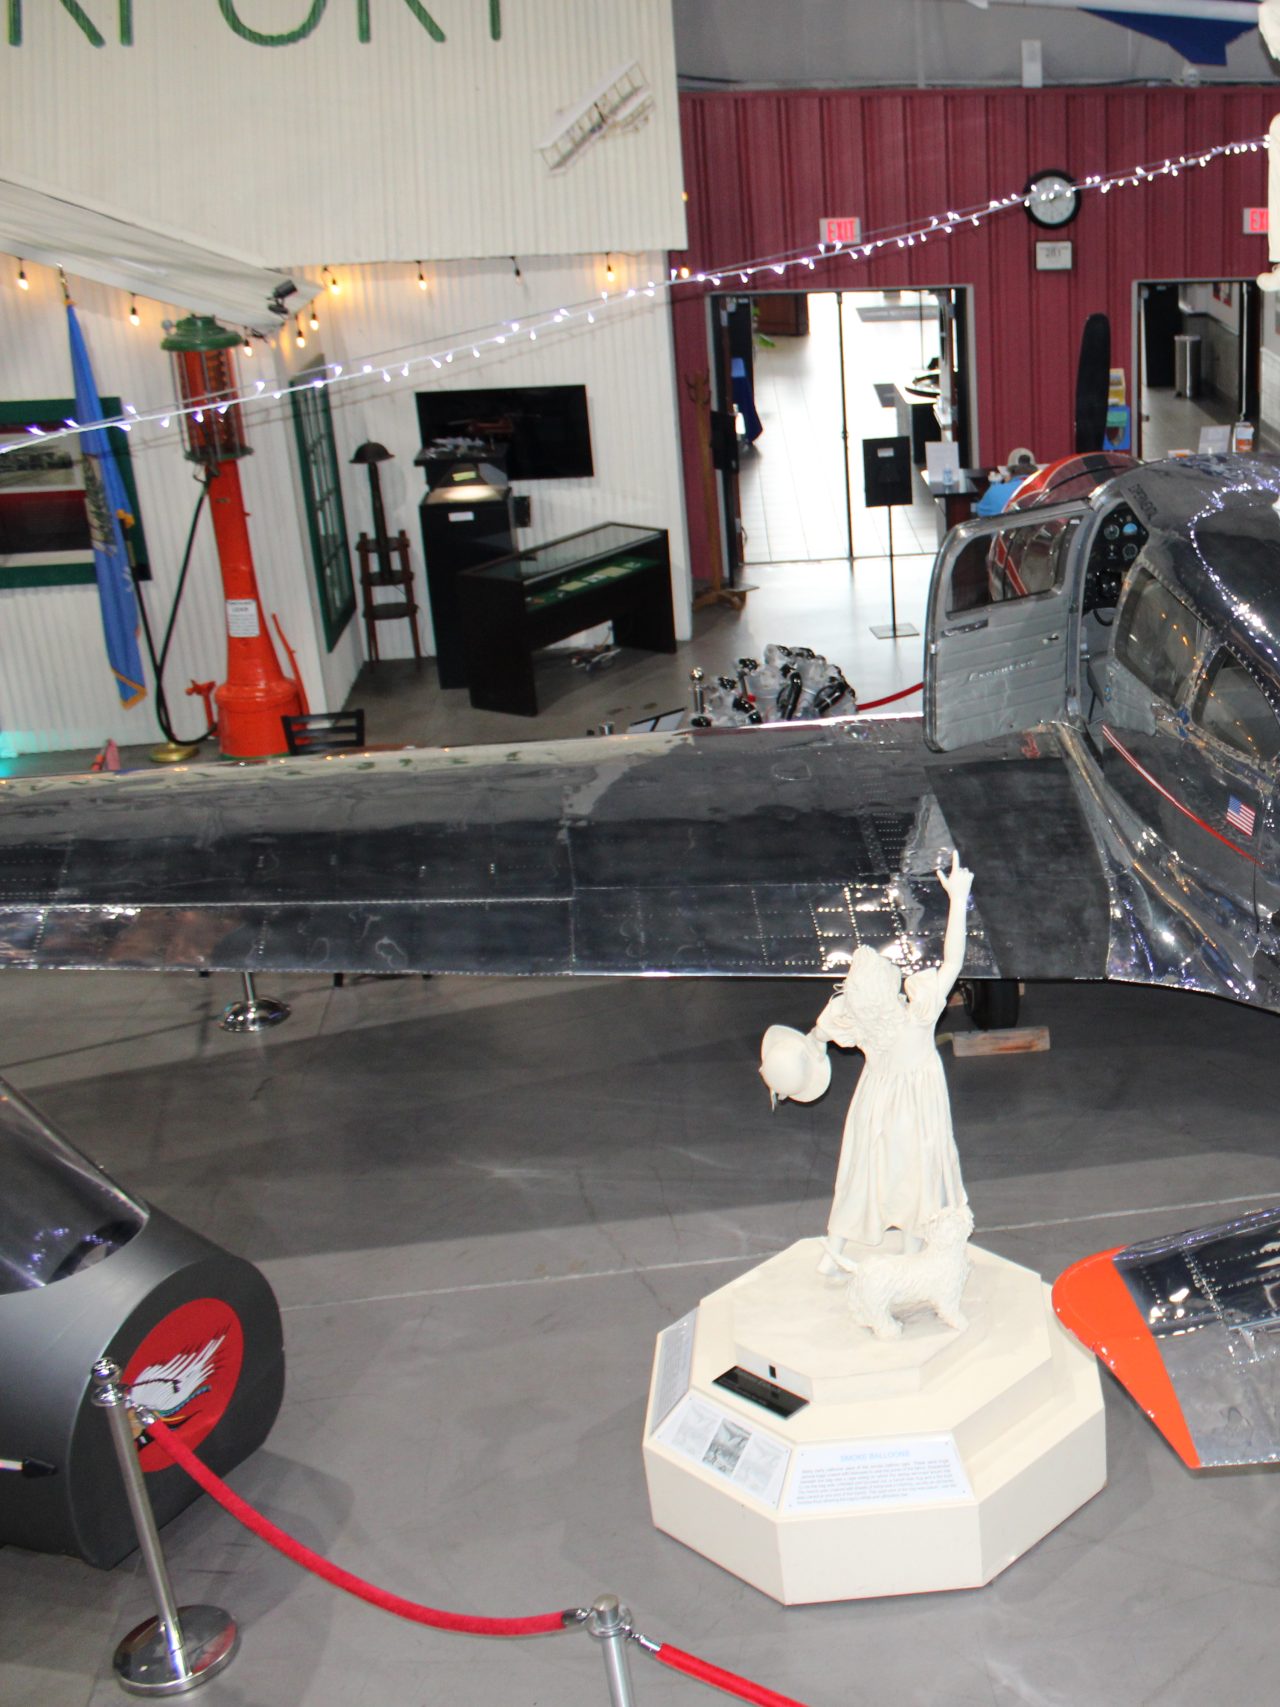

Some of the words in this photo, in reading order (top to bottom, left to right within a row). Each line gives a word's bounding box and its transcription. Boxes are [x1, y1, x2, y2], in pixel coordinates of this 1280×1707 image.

[826, 220, 854, 242] EXIT
[968, 659, 1034, 681] Executive
[840, 1453, 867, 1463] SMOKE
[869, 1450, 911, 1461] BALLOONS
